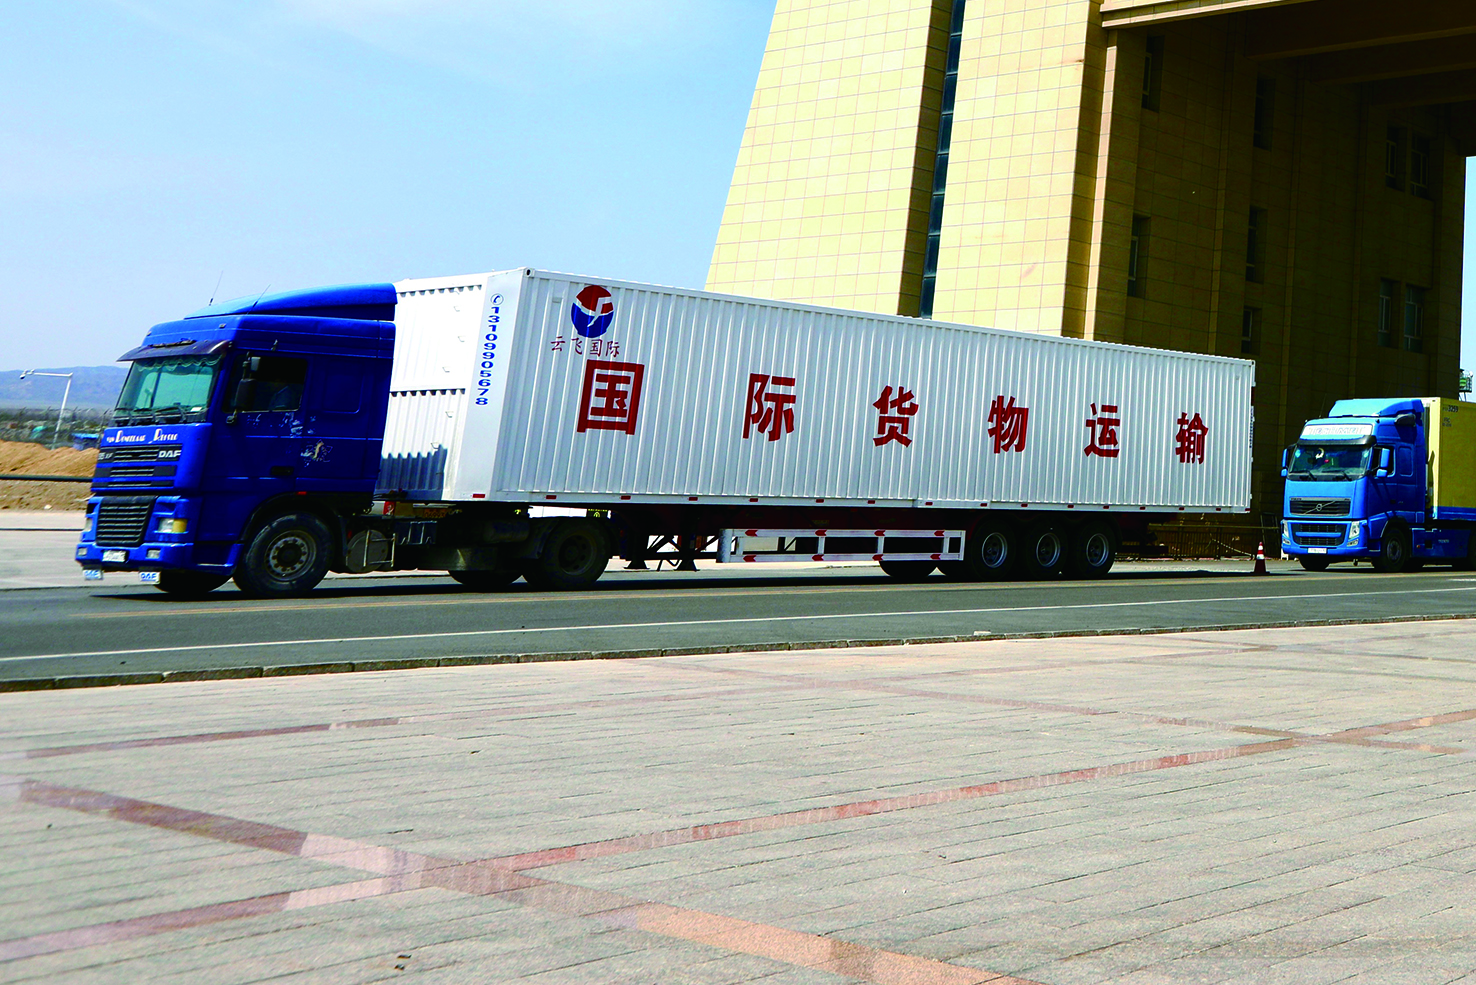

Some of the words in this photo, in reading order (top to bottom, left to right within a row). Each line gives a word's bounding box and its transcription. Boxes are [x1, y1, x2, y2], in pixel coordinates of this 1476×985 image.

[475, 306, 500, 406] 13109905678
[550, 336, 621, 358] 云飞国际
[577, 359, 1209, 464] 国际货物运输
[158, 450, 182, 458] DAF
